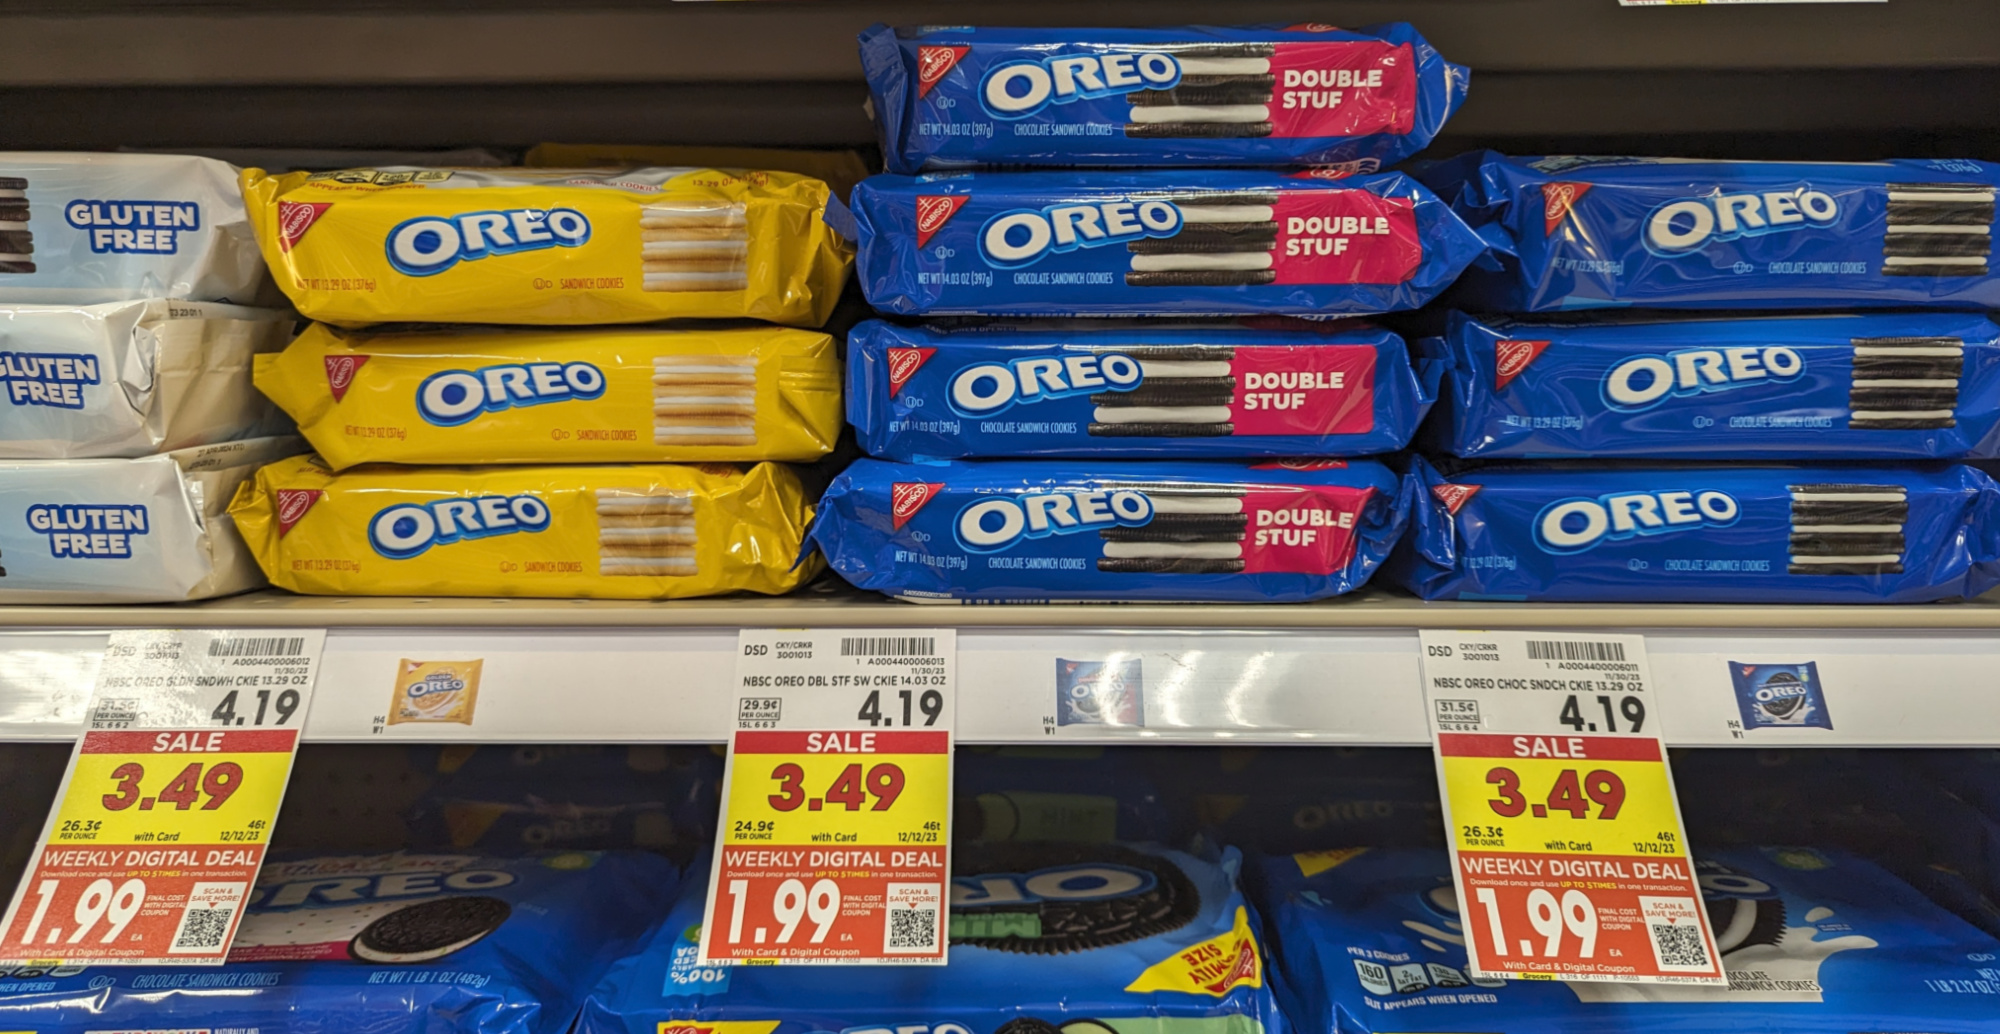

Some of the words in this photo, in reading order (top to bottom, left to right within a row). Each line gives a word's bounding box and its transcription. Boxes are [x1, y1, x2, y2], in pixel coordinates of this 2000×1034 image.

[923, 49, 953, 81] NABISCO
[986, 53, 1178, 111] OREO
[1284, 69, 1383, 88] DOUBLE
[1282, 90, 1343, 109] STUF
[919, 123, 932, 136] NET
[932, 123, 942, 136] WT
[943, 123, 960, 136] 14.03
[961, 123, 971, 136] OZ
[971, 121, 994, 139] (397g)
[1014, 124, 1050, 136] CHOCOLATE
[1051, 124, 1085, 136] SANDWICH
[1086, 124, 1112, 136] COOKIES
[69, 204, 195, 227] GLUTEN
[286, 204, 314, 237] NABISCO
[920, 199, 951, 232] NABISCO
[1649, 190, 1838, 248] OREO
[985, 201, 1178, 261] OREO
[1287, 216, 1390, 235] DOUBLE
[95, 229, 173, 251] FREE
[393, 210, 588, 266] OREO
[1285, 238, 1349, 256] STUF
[560, 278, 595, 290] SANDWICH
[596, 277, 624, 289] COOKIES
[1014, 272, 1050, 285] CHOCOLATE
[1051, 272, 1085, 285] SANDWICH
[1086, 272, 1113, 285] COOKIES
[892, 352, 919, 381] NABISCO
[1499, 344, 1531, 375] NABISCO
[953, 354, 1139, 410] OREO
[1244, 372, 1344, 389] DOUBLE
[1607, 346, 1802, 404] OREO
[11, 381, 81, 406] FREE
[423, 363, 602, 417] OREO
[1244, 392, 1306, 410] STUF
[577, 429, 610, 441] SANDWICH
[611, 429, 637, 441] COOKIES
[282, 494, 308, 521] NABISCO
[896, 484, 926, 515] NABISCO
[30, 508, 145, 531] GLUTEN
[375, 497, 547, 550] OREO
[960, 491, 1150, 545] OREO
[1256, 509, 1354, 528] DOUBLE
[1542, 491, 1738, 546] OREO
[53, 533, 129, 555] FREE
[1255, 529, 1317, 546] STUF
[744, 644, 768, 656] DSD
[775, 641, 813, 649] CKY/CRKR
[776, 651, 813, 659] 3001013
[409, 681, 463, 697] OREO
[743, 676, 771, 687] NBSC
[774, 676, 805, 687] OREO
[807, 676, 829, 687] DBL
[831, 676, 850, 687] STF
[853, 676, 871, 686] SW
[873, 675, 898, 686] CKIE
[900, 675, 928, 686] 14.03
[931, 675, 946, 686] OZ
[1433, 677, 1462, 689] NBSC
[1464, 678, 1494, 689] OREO
[1497, 678, 1528, 690] CHOC
[1530, 679, 1567, 691] SNDCH
[1569, 680, 1594, 691] CKIE
[1596, 681, 1624, 691] 13.29
[1627, 682, 1644, 692] OZ
[1755, 686, 1807, 702] OREO
[211, 688, 301, 726] 4.19
[743, 699, 778, 711] 29.9¢
[858, 689, 944, 726] 4.19
[1559, 694, 1646, 733] 4.19
[152, 732, 225, 752] SALE
[806, 732, 877, 752] SALE
[1513, 736, 1587, 759] SALE
[102, 762, 243, 811] 3.49
[768, 762, 905, 812] 3.49
[1485, 767, 1626, 820] 3.49
[61, 820, 102, 831] 26.3¢
[248, 820, 266, 829] 46t
[734, 820, 775, 832] 24.9¢
[923, 821, 941, 831] 46t
[1462, 826, 1504, 838] 26.3¢
[59, 832, 73, 840] PER
[73, 832, 97, 840] OUNCE
[134, 831, 155, 842] with
[156, 832, 180, 842] Card
[220, 831, 260, 841] 12/12/23
[734, 832, 749, 840] PER
[749, 832, 772, 840] OUNCE
[811, 832, 833, 842] with
[834, 832, 857, 843] Card
[898, 832, 937, 842] 12/12/23
[1466, 838, 1480, 846] PER
[1480, 839, 1505, 847] OUNCE
[1657, 831, 1675, 842] 46t
[1544, 841, 1567, 850] with
[1568, 841, 1592, 852] Card
[1633, 842, 1675, 853] 12/12/23
[43, 851, 124, 867] WEEKLY
[125, 850, 200, 867] DIGITAL
[204, 850, 256, 866] DEAL
[726, 851, 805, 867] WEEKLY
[809, 851, 886, 867] DIGITAL
[891, 851, 943, 867] DEAL
[726, 870, 764, 878] Download
[785, 870, 799, 878] and
[895, 870, 938, 878] transaction.
[1462, 857, 1544, 876] WEEKLY
[1550, 860, 1630, 879] DIGITAL
[1633, 862, 1689, 881] DEAL
[843, 894, 863, 902] FINAL
[864, 894, 882, 902] COST
[843, 902, 860, 910] WITH
[861, 902, 886, 910] DIGITAL
[20, 878, 146, 944] 1.99
[728, 878, 841, 944] 1.99
[842, 909, 871, 917] COUPON
[1475, 887, 1598, 959] 1.99
[130, 934, 143, 942] EA
[840, 933, 853, 942] EA
[731, 948, 754, 957] With
[756, 948, 779, 957] Card
[780, 948, 788, 957] &
[789, 948, 821, 958] Digital
[823, 949, 860, 959] Coupon
[1181, 943, 1223, 967] SIZE
[1609, 948, 1623, 957] EA
[670, 968, 726, 985] 100%
[1359, 963, 1383, 980] 160
[131, 974, 185, 989] CHOCOLATE
[185, 972, 237, 988] SANDWICH
[240, 972, 282, 987] COOKIES
[1384, 997, 1427, 1011] APPEARS
[1428, 995, 1458, 1004] WHEN
[1460, 994, 1498, 1004] OPENED
